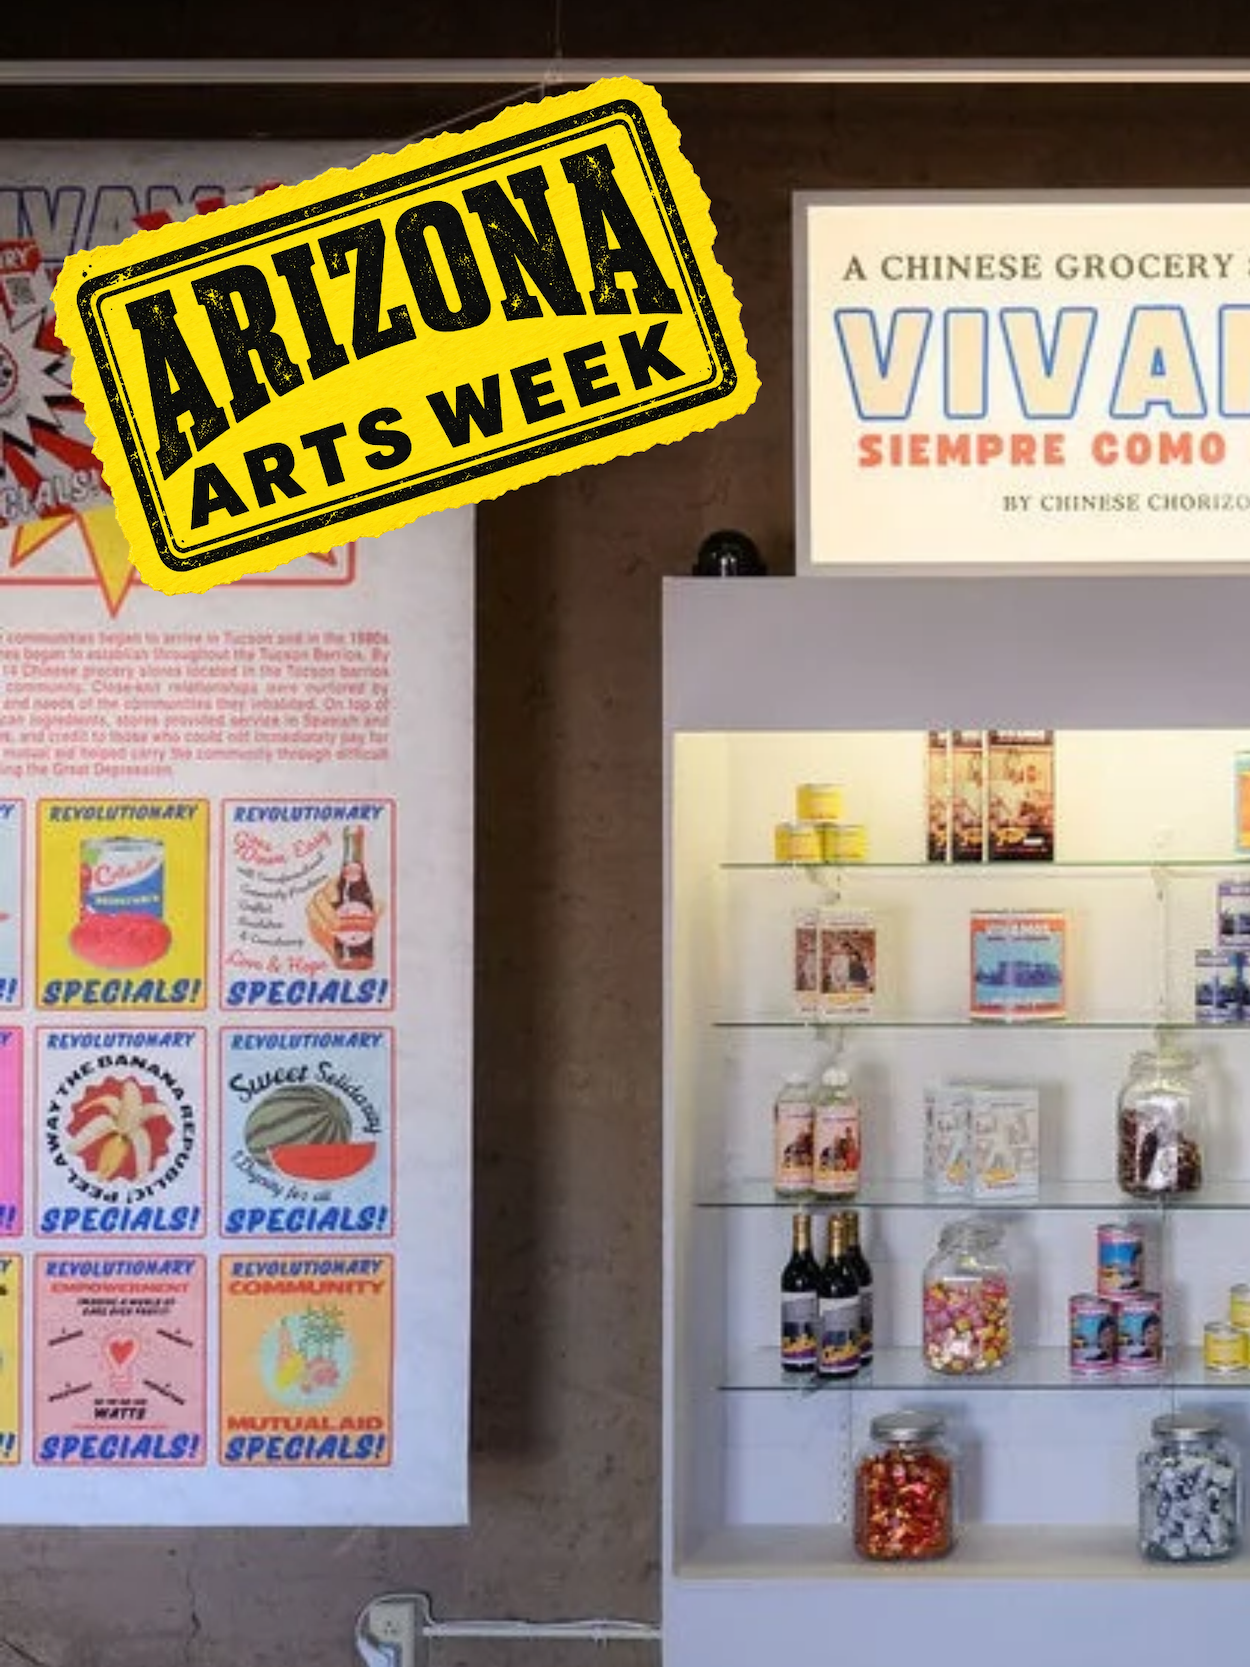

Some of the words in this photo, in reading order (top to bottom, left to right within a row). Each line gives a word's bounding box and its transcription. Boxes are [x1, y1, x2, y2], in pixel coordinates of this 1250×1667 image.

[843, 256, 867, 281] A
[881, 255, 1043, 281] CHINESE
[1055, 253, 1235, 281] GROCERY
[857, 433, 1067, 468] SIEMPRE
[1092, 431, 1227, 466] COMO
[1003, 495, 1032, 512] BY
[1039, 495, 1139, 511] CHINESE
[49, 805, 198, 821] REVOLUTIONARY
[233, 806, 384, 822] REVOLUTIONARY
[42, 978, 201, 1006] SPECIALS!
[227, 979, 388, 1006] SPECIALS!
[47, 1032, 196, 1049] REVOLUTIONARY
[231, 1032, 383, 1049] REVOLUTIONARY
[97, 1055, 185, 1101] BANANA
[41, 1206, 199, 1233] SPECIALS!
[225, 1205, 388, 1233] SPECIALS!
[46, 1260, 195, 1277] REVOLUTIONARY
[231, 1260, 384, 1277] REVOLUTIONARY
[227, 1280, 385, 1296] COMMUNITY
[94, 1406, 146, 1421] WATTS
[227, 1416, 338, 1431] MUTUAL
[341, 1416, 384, 1431] AID
[41, 1433, 199, 1460] SPECIALS!
[225, 1434, 386, 1462] SPECIALS!
